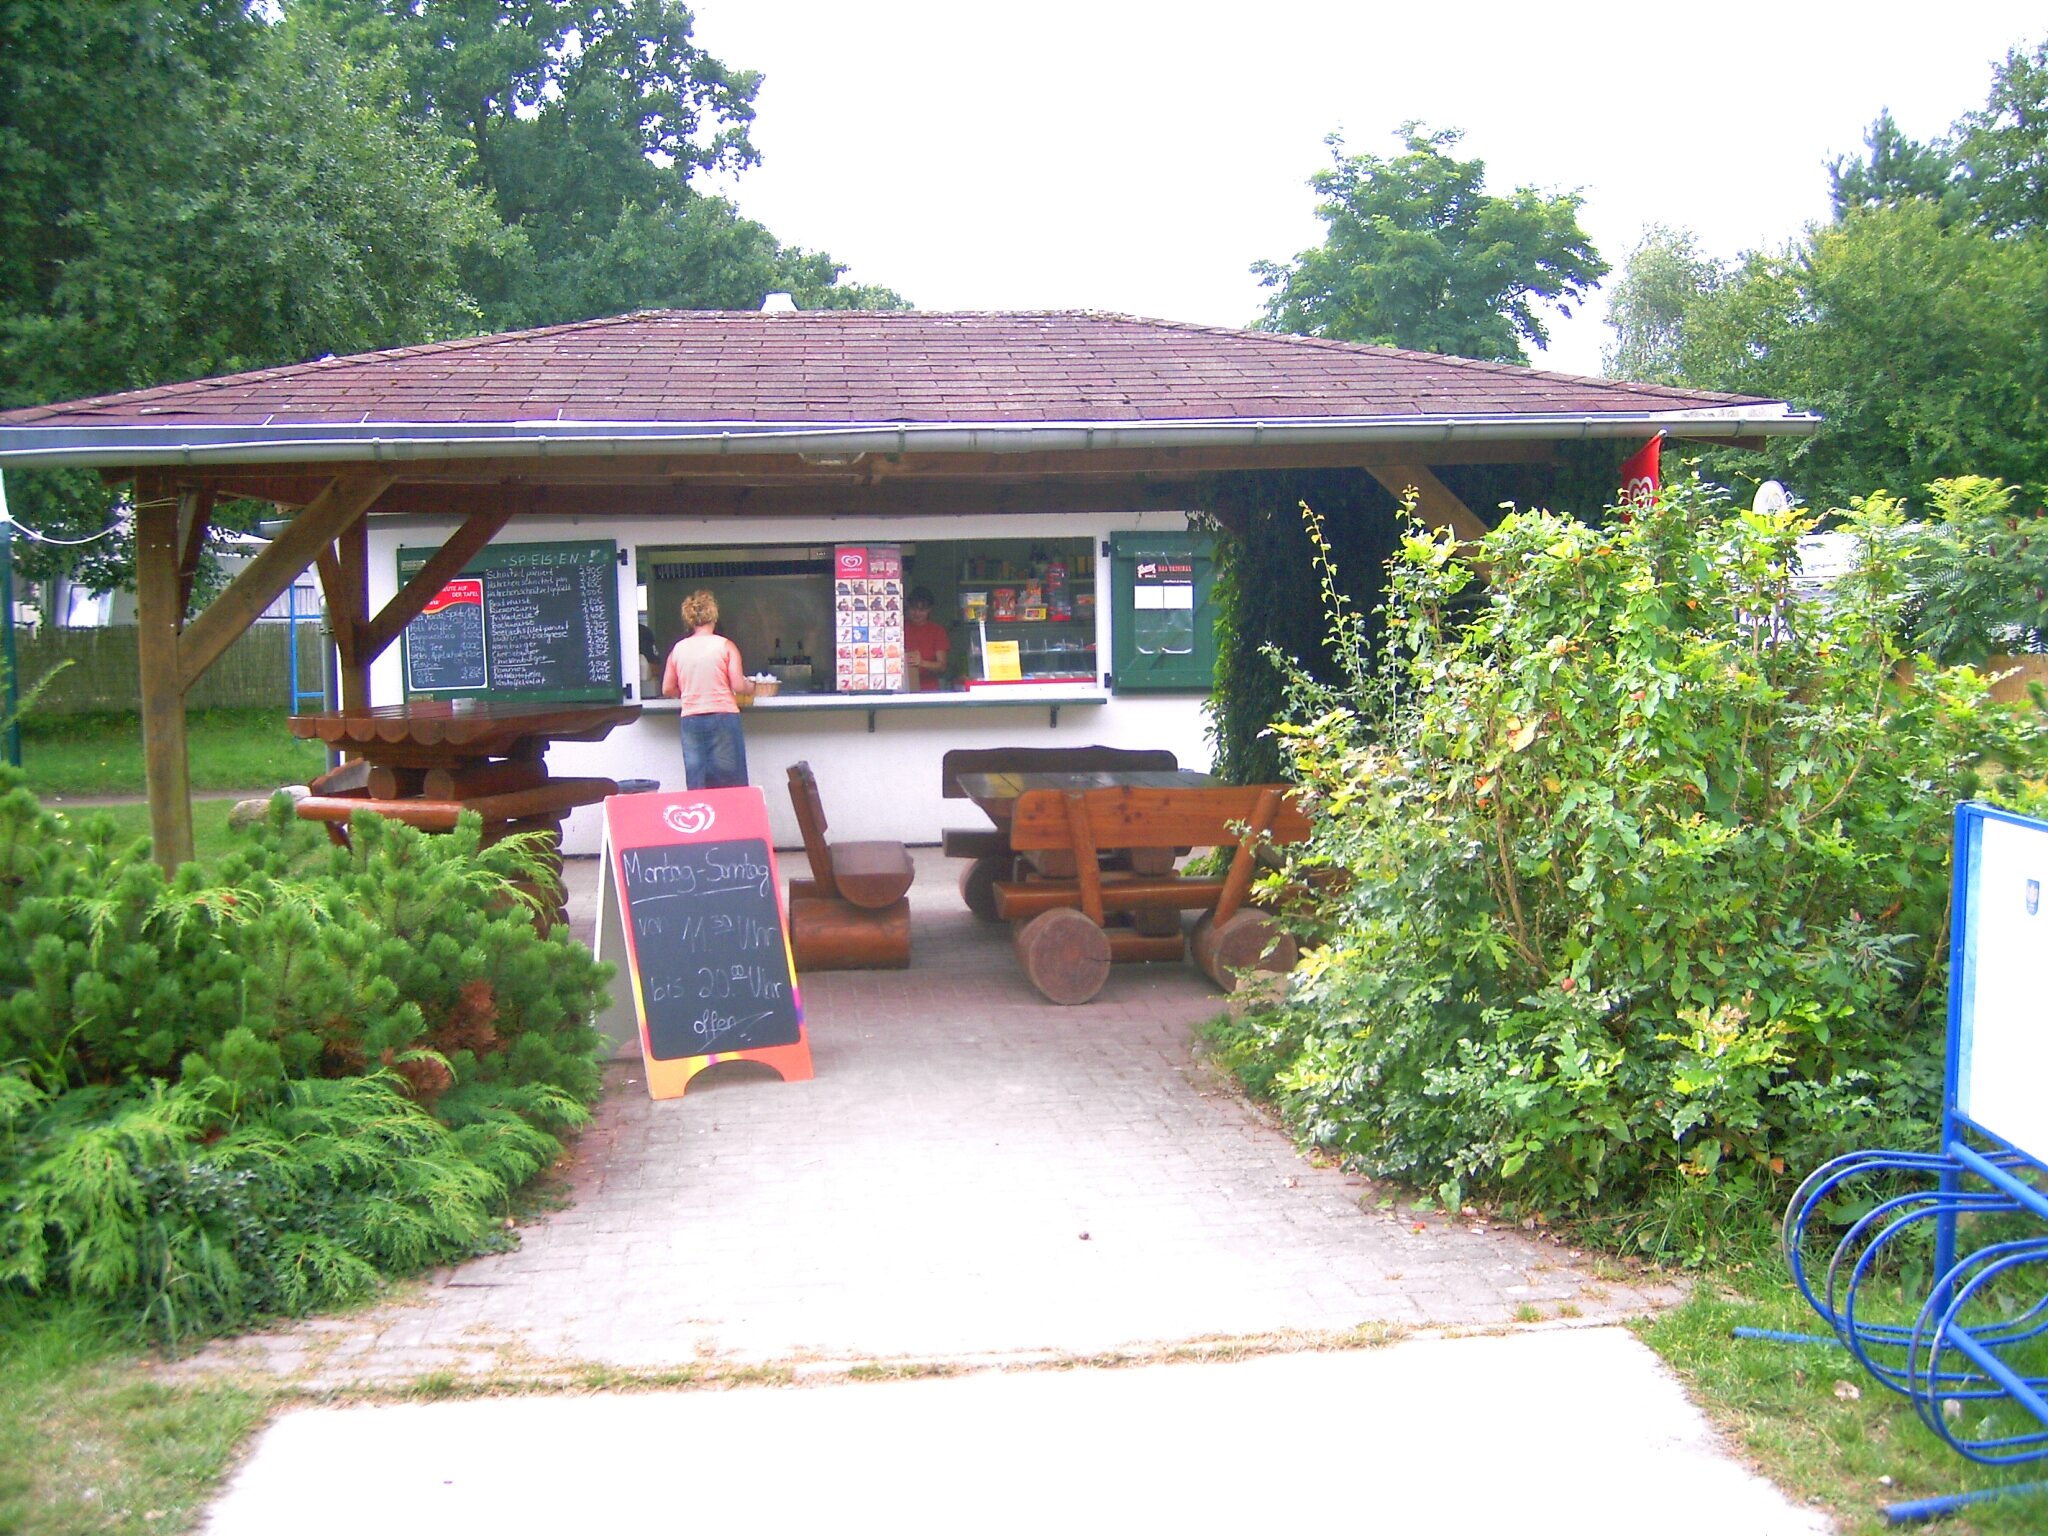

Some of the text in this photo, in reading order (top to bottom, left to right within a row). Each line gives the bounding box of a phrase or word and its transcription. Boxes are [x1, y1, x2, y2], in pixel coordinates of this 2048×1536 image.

[509, 552, 579, 567] SPEISEN
[737, 916, 779, 950] Uhr
[650, 976, 685, 1002] bis
[748, 967, 783, 999] Uhr
[693, 1008, 737, 1042] offen
